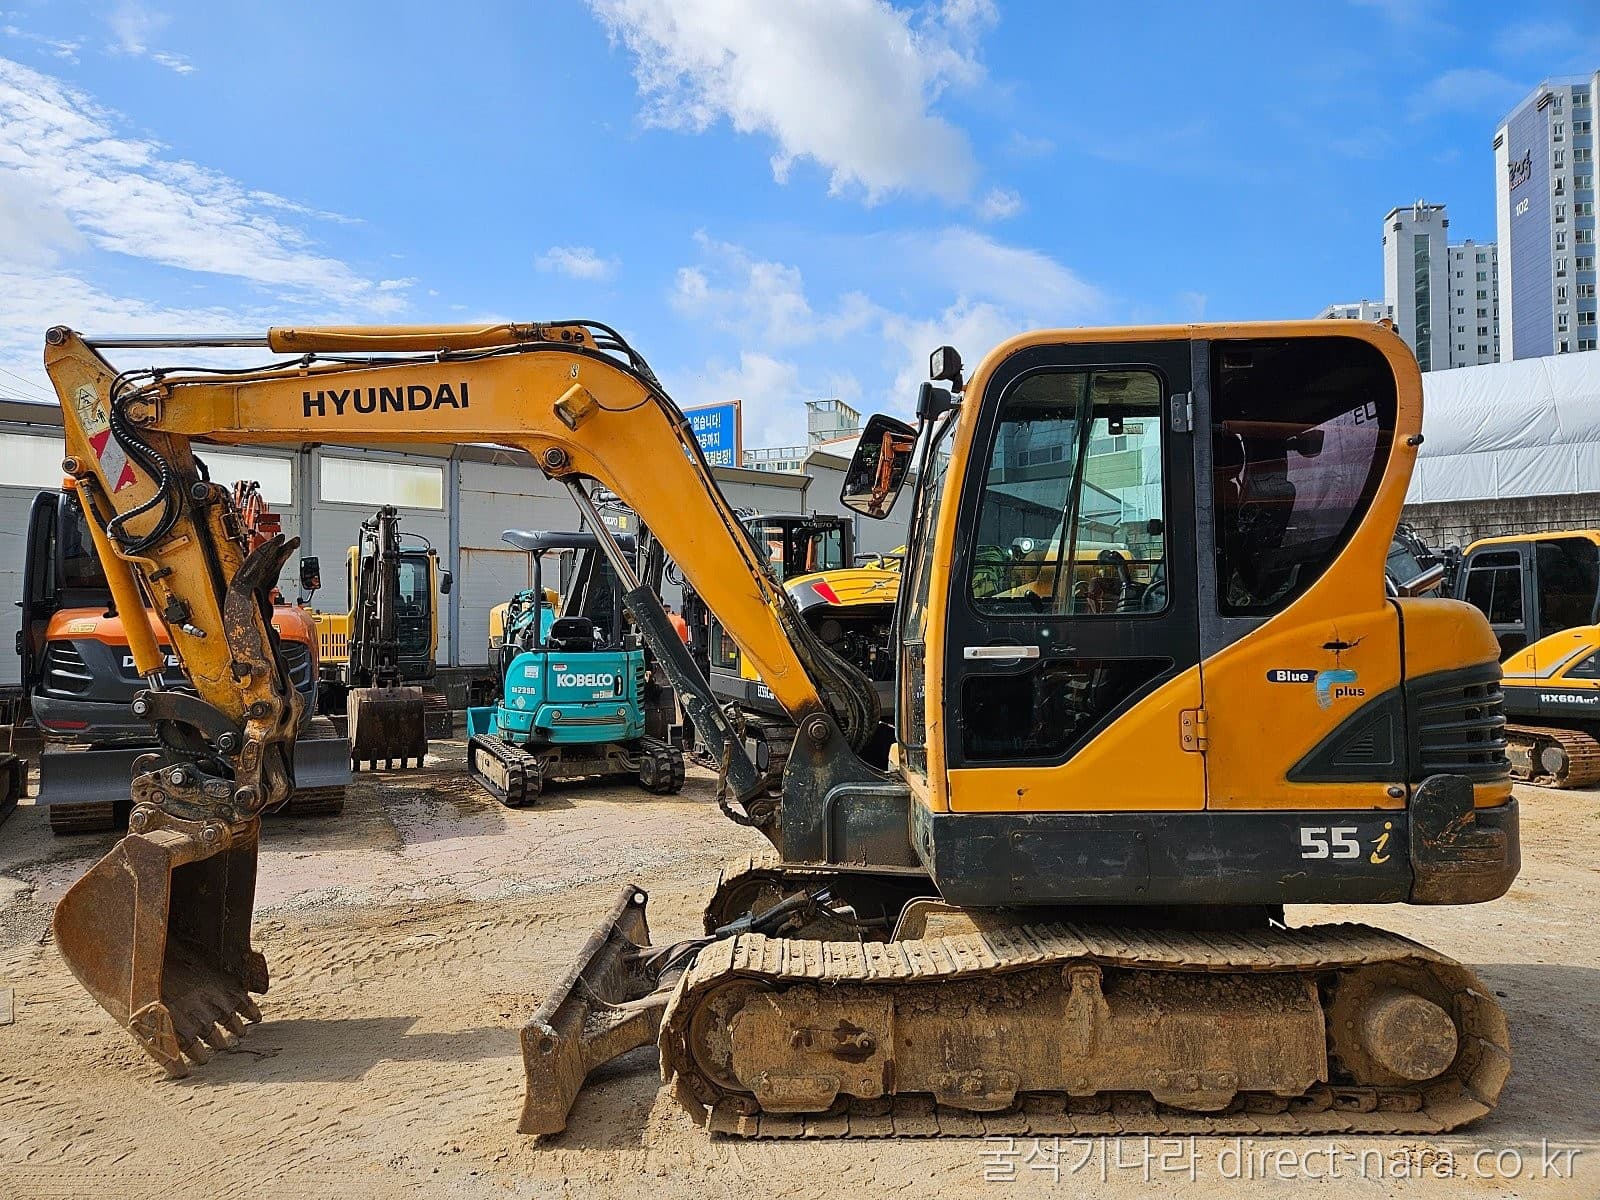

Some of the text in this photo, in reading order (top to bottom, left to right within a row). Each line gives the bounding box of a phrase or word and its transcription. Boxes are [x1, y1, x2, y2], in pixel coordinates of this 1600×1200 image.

[1515, 197, 1529, 216] 102
[302, 382, 469, 418] HYUNDAI
[556, 673, 614, 687] KOBELCO
[1276, 671, 1309, 681] Blue
[1335, 686, 1365, 698] plus
[1300, 821, 1392, 864] 55 i
